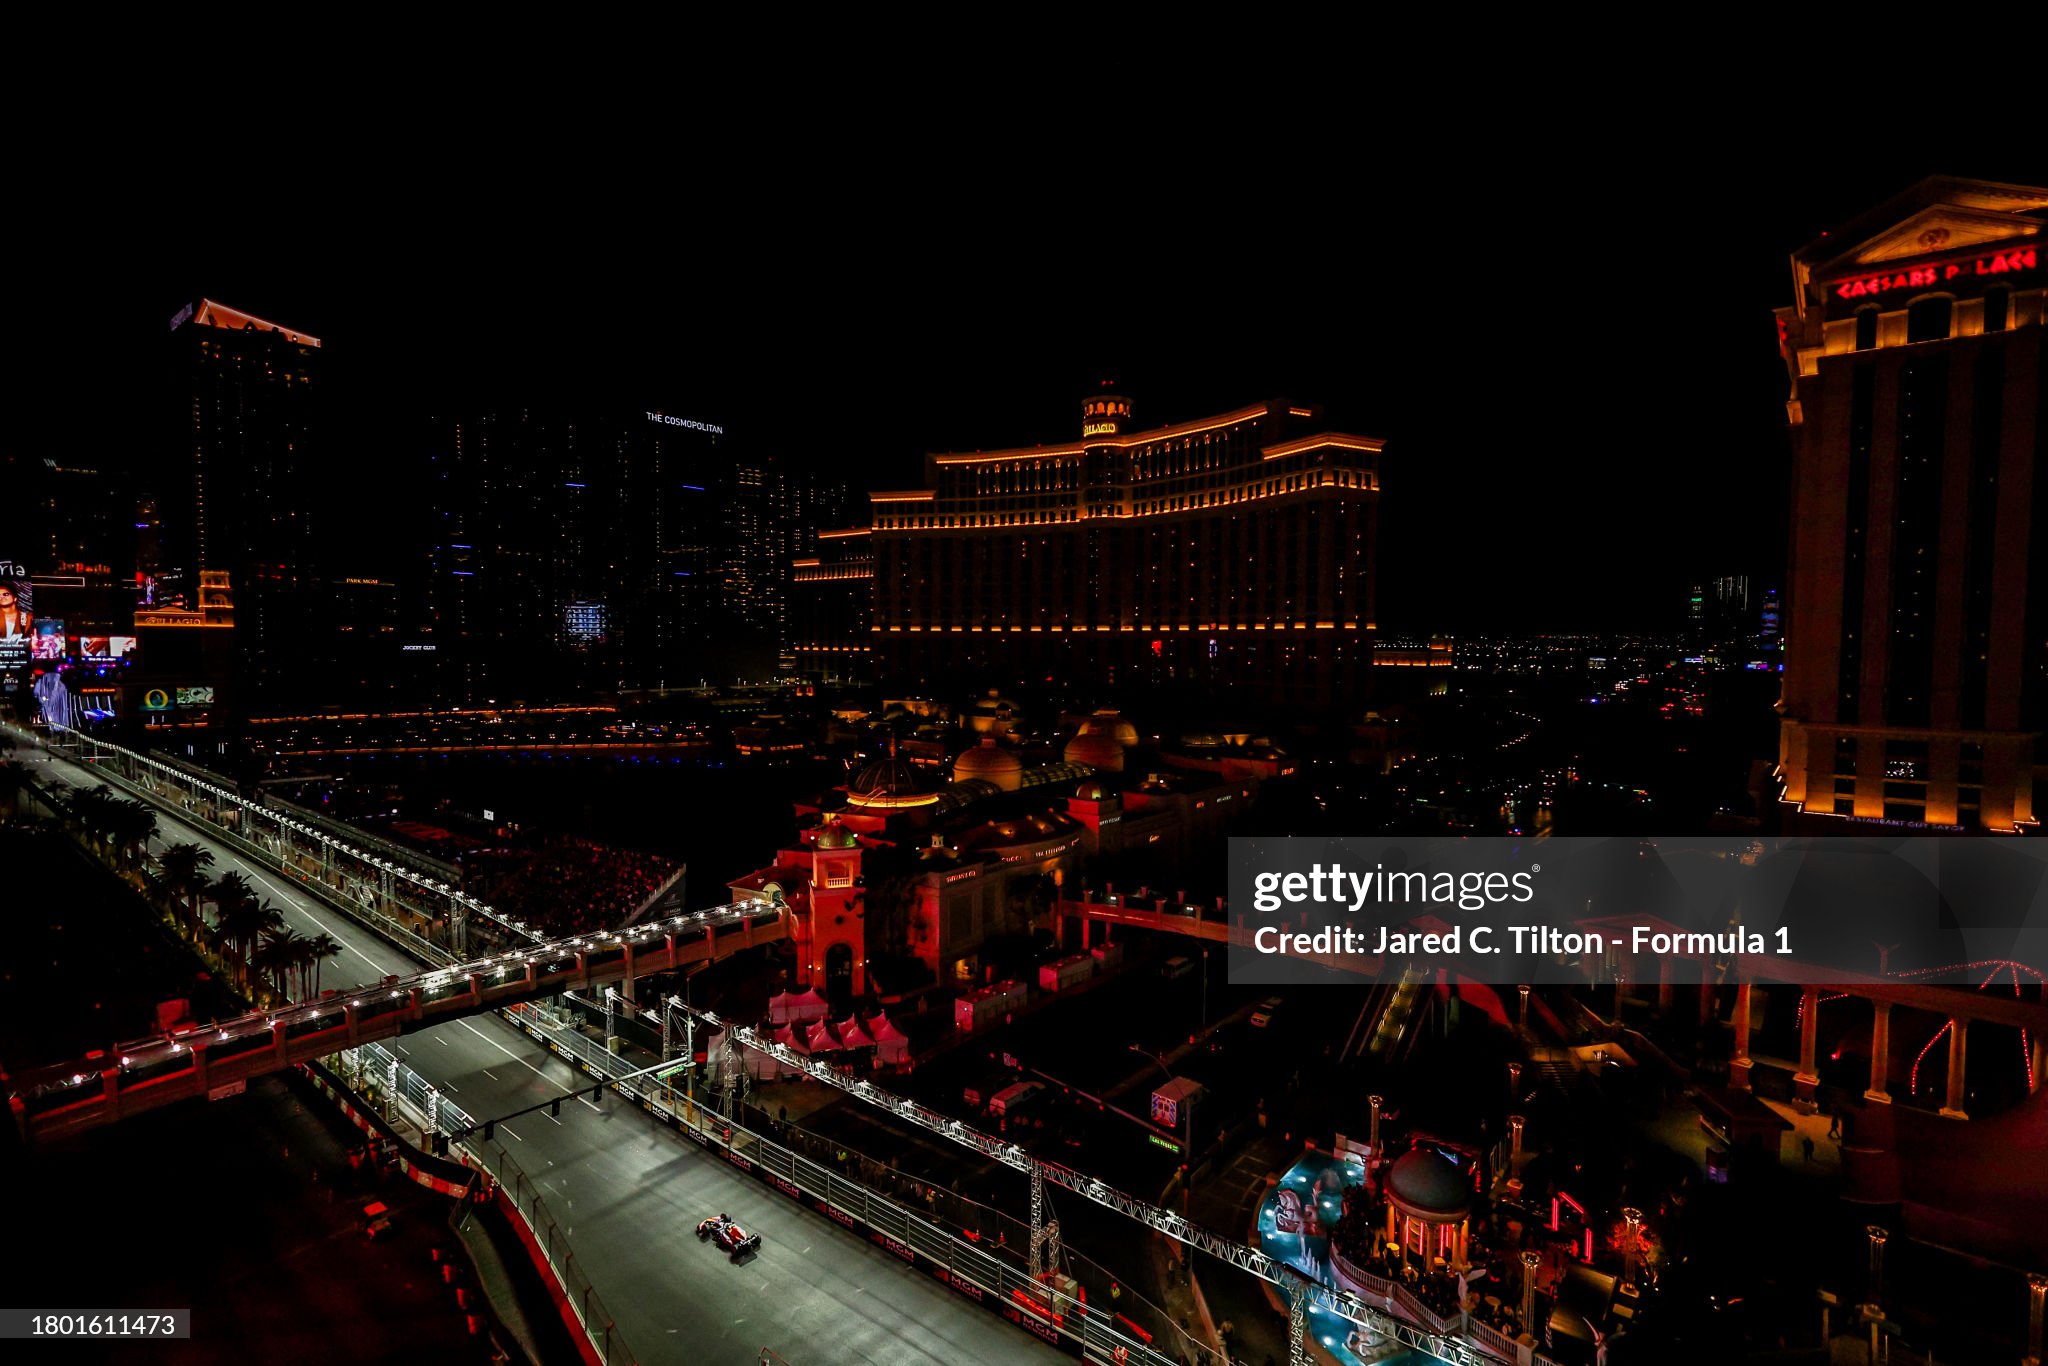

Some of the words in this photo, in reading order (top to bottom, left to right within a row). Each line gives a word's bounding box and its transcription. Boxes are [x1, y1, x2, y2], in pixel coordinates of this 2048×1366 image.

[1837, 267, 1938, 299] CAESARS
[645, 411, 663, 423] THE
[664, 415, 723, 435] COSMOPOLITAN
[346, 577, 362, 585] PARK
[1845, 815, 1905, 827] RESTAURANT
[1907, 821, 1928, 830] GUY
[558, 1046, 574, 1061] MGM
[589, 1065, 603, 1079] MGM
[619, 1085, 635, 1098] MGM
[652, 1105, 669, 1120] MGM
[689, 1128, 707, 1143] MGM
[730, 1153, 751, 1168] MGM
[777, 1178, 800, 1194] MGM
[828, 1206, 854, 1225] MGM
[886, 1238, 914, 1258] MGM
[951, 1274, 983, 1297] MGM
[1023, 1315, 1059, 1340] MGM
